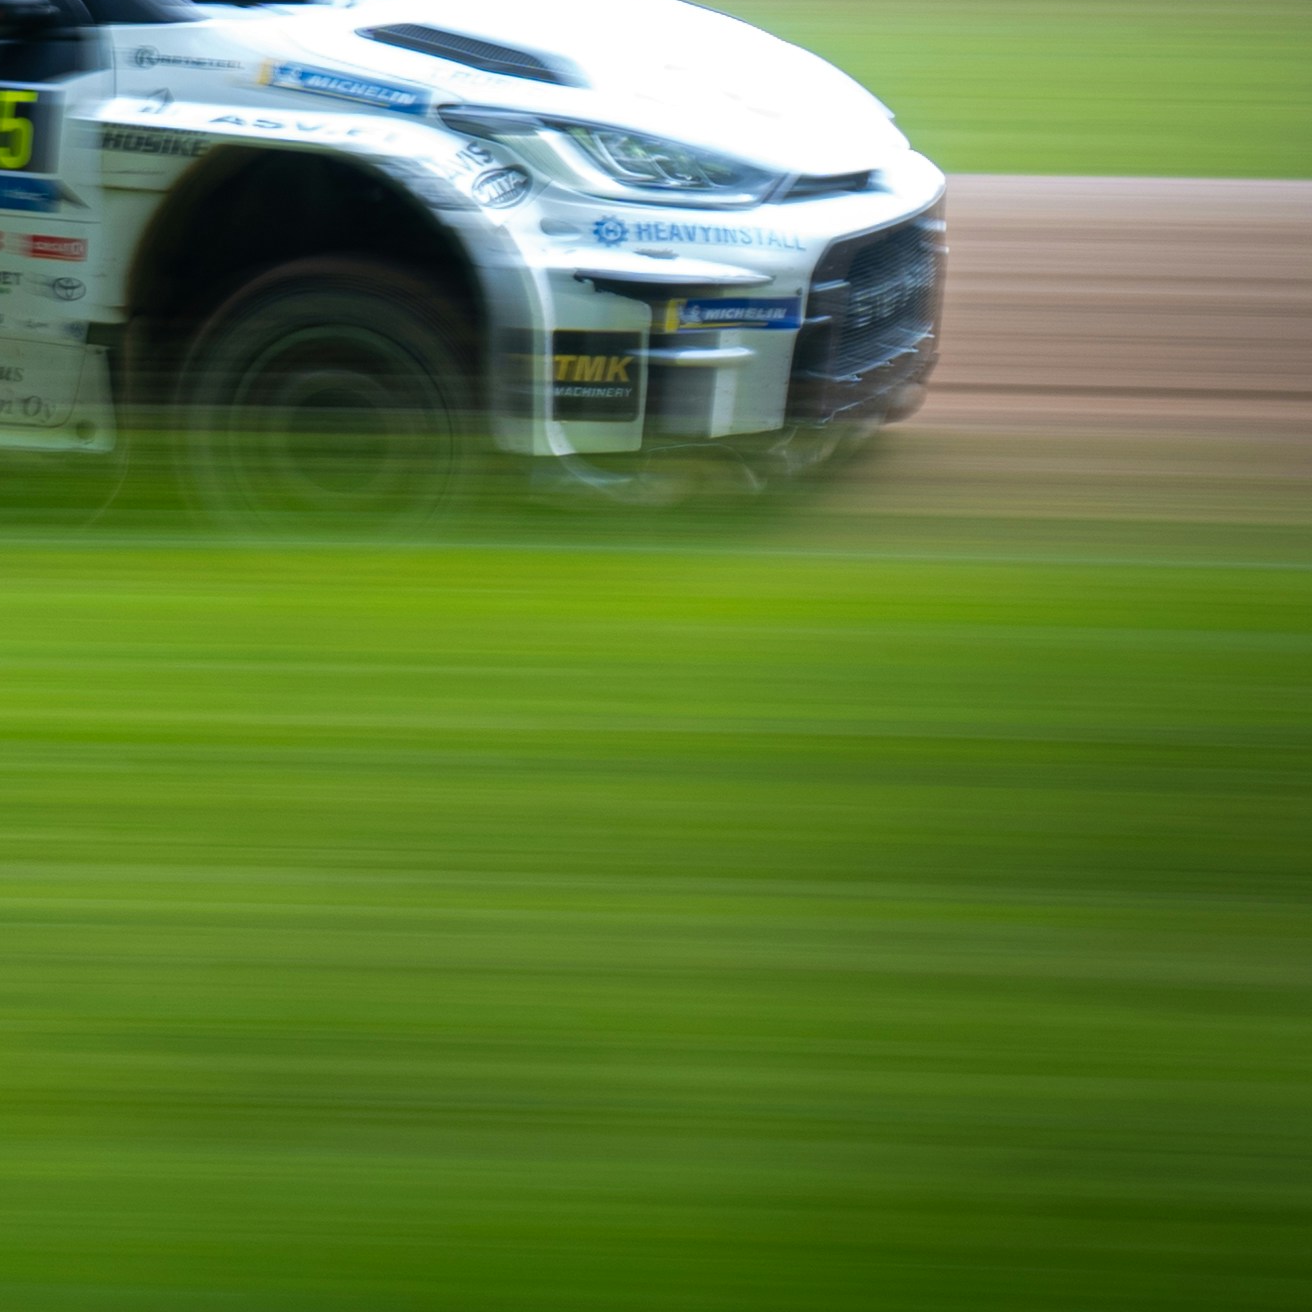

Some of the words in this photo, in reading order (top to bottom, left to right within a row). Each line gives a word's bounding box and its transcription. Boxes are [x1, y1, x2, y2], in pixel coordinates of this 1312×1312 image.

[309, 74, 417, 106] MICHELIN
[636, 221, 807, 251] HEAVYINSTALL
[705, 307, 787, 320] MICHELIN
[554, 355, 634, 382] TMK
[555, 387, 633, 398] MACHINERY
